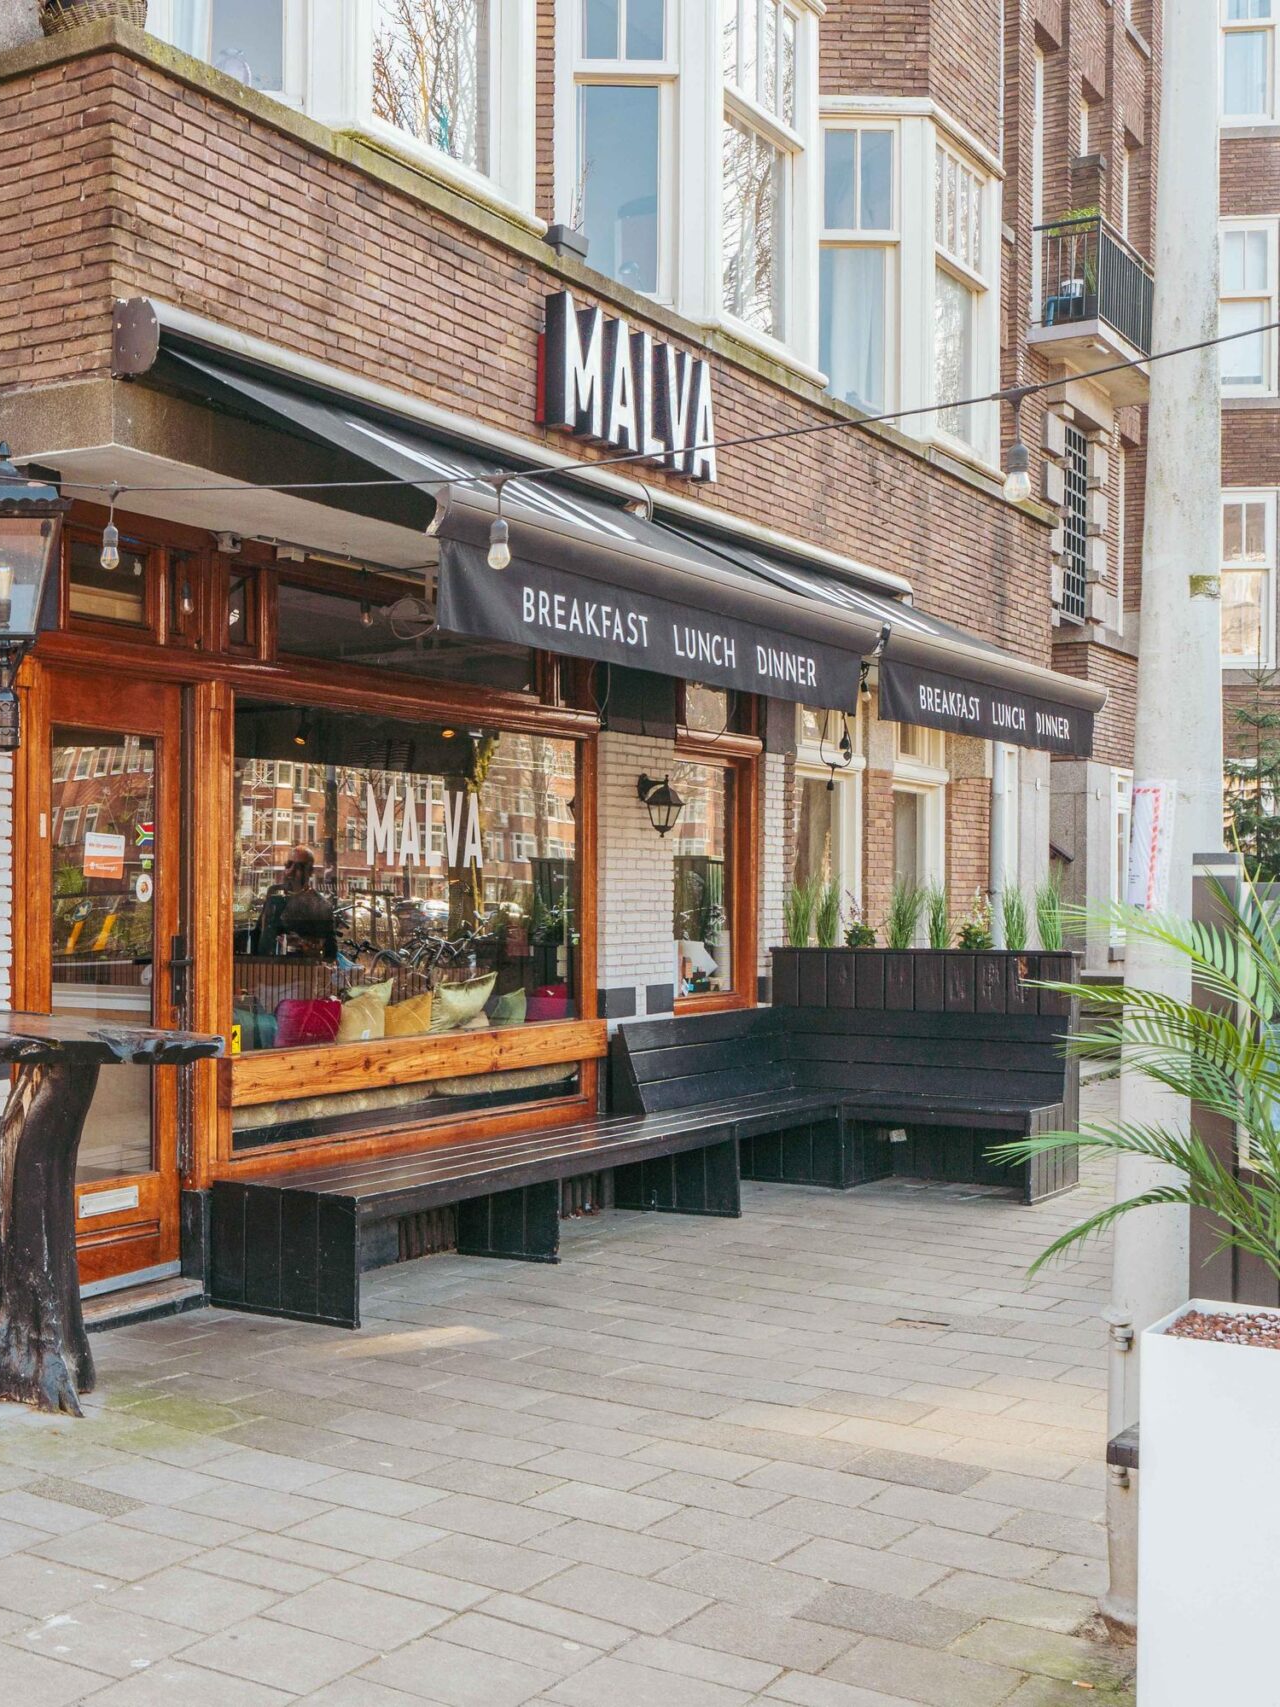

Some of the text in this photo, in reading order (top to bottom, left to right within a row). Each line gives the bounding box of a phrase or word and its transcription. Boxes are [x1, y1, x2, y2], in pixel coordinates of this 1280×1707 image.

[564, 290, 718, 483] MALVA
[522, 586, 818, 687] BREAKFAST LUNCH DINNER
[919, 684, 1070, 740] BREAKFAST LUNCH DINNER
[366, 783, 484, 869] MALVA
